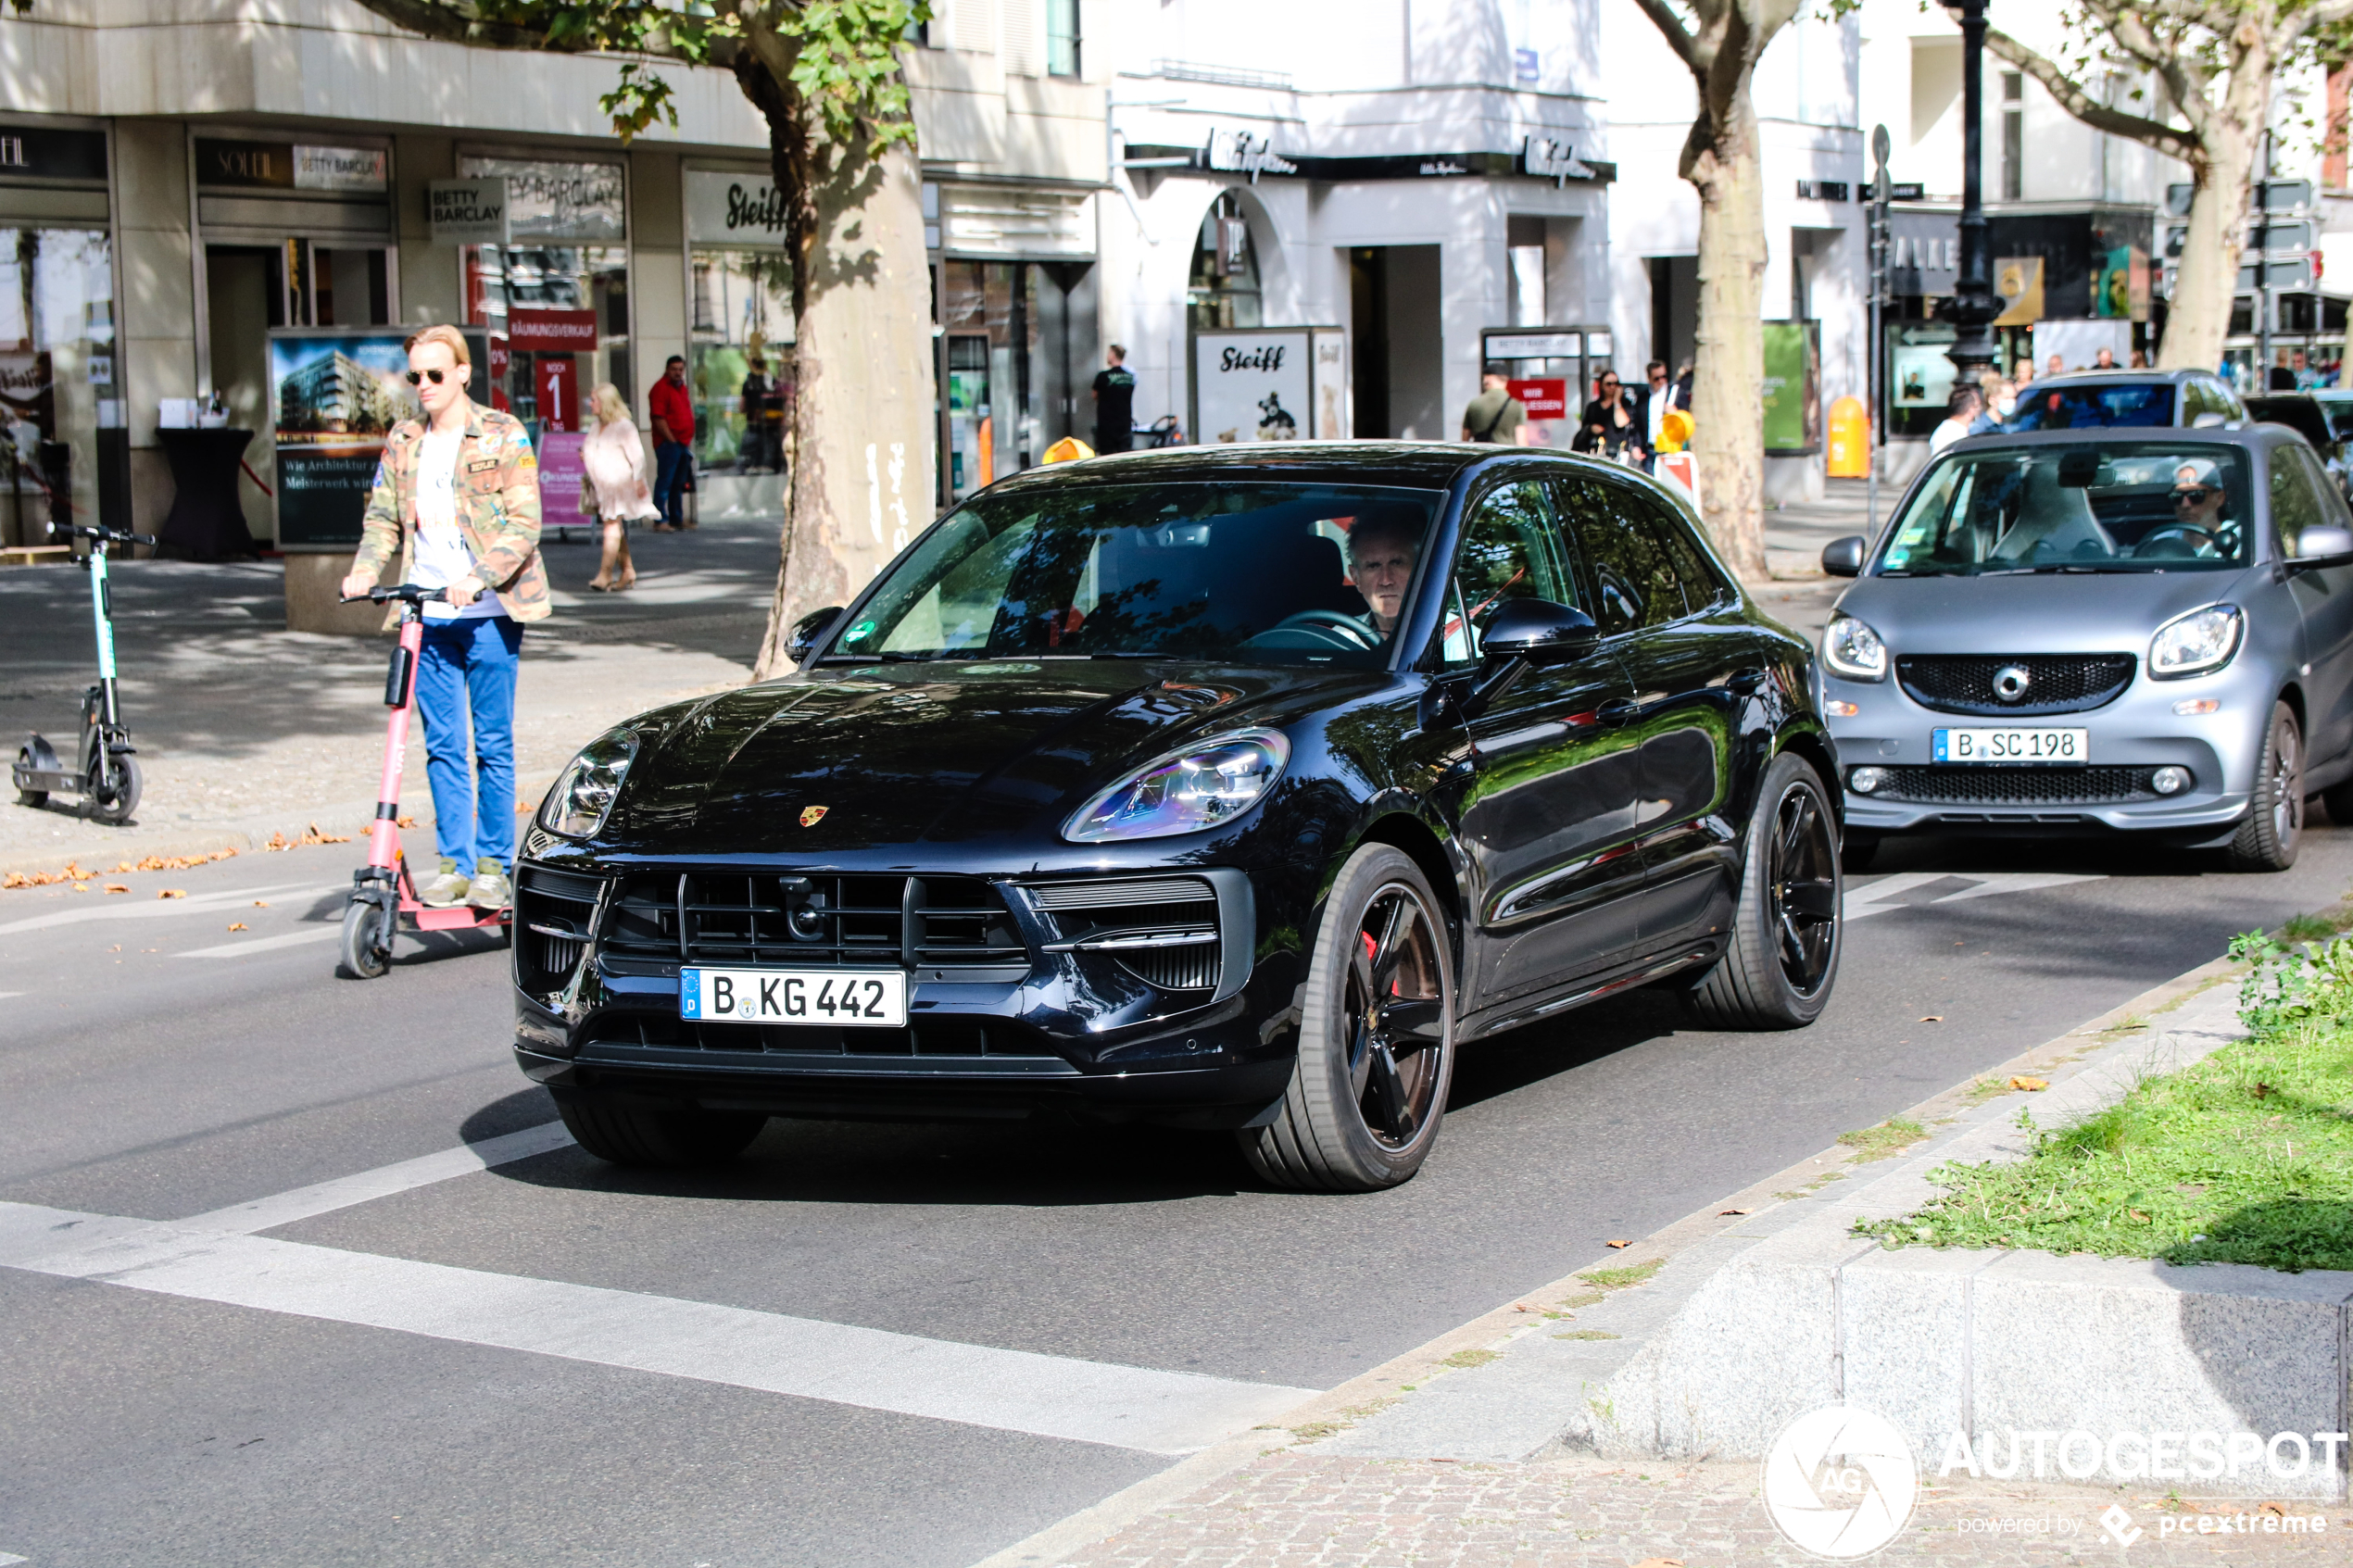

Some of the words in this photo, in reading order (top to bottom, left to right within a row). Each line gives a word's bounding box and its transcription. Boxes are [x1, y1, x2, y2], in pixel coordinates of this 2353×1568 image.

[301, 157, 333, 173] BETTY
[434, 189, 479, 206] BETTY
[434, 206, 502, 223] BARCLAY
[510, 320, 595, 338] RÄUMUNGSVERKAUF
[1220, 345, 1286, 372] Steiff
[547, 374, 560, 420] 1
[1523, 388, 1543, 398] WIR
[1520, 400, 1562, 411] LIESSEN
[285, 459, 305, 471] Wie
[308, 459, 368, 471] Architektur
[470, 460, 497, 472] REPLAY
[285, 477, 350, 489] Meisterwerk
[1938, 747, 1945, 757] D
[1957, 734, 1973, 757] B
[1992, 734, 2022, 757] SC
[2029, 734, 2075, 757] 198
[686, 998, 696, 1011] D
[714, 976, 736, 1014] B
[761, 977, 807, 1016] KG
[816, 979, 885, 1018] 442
